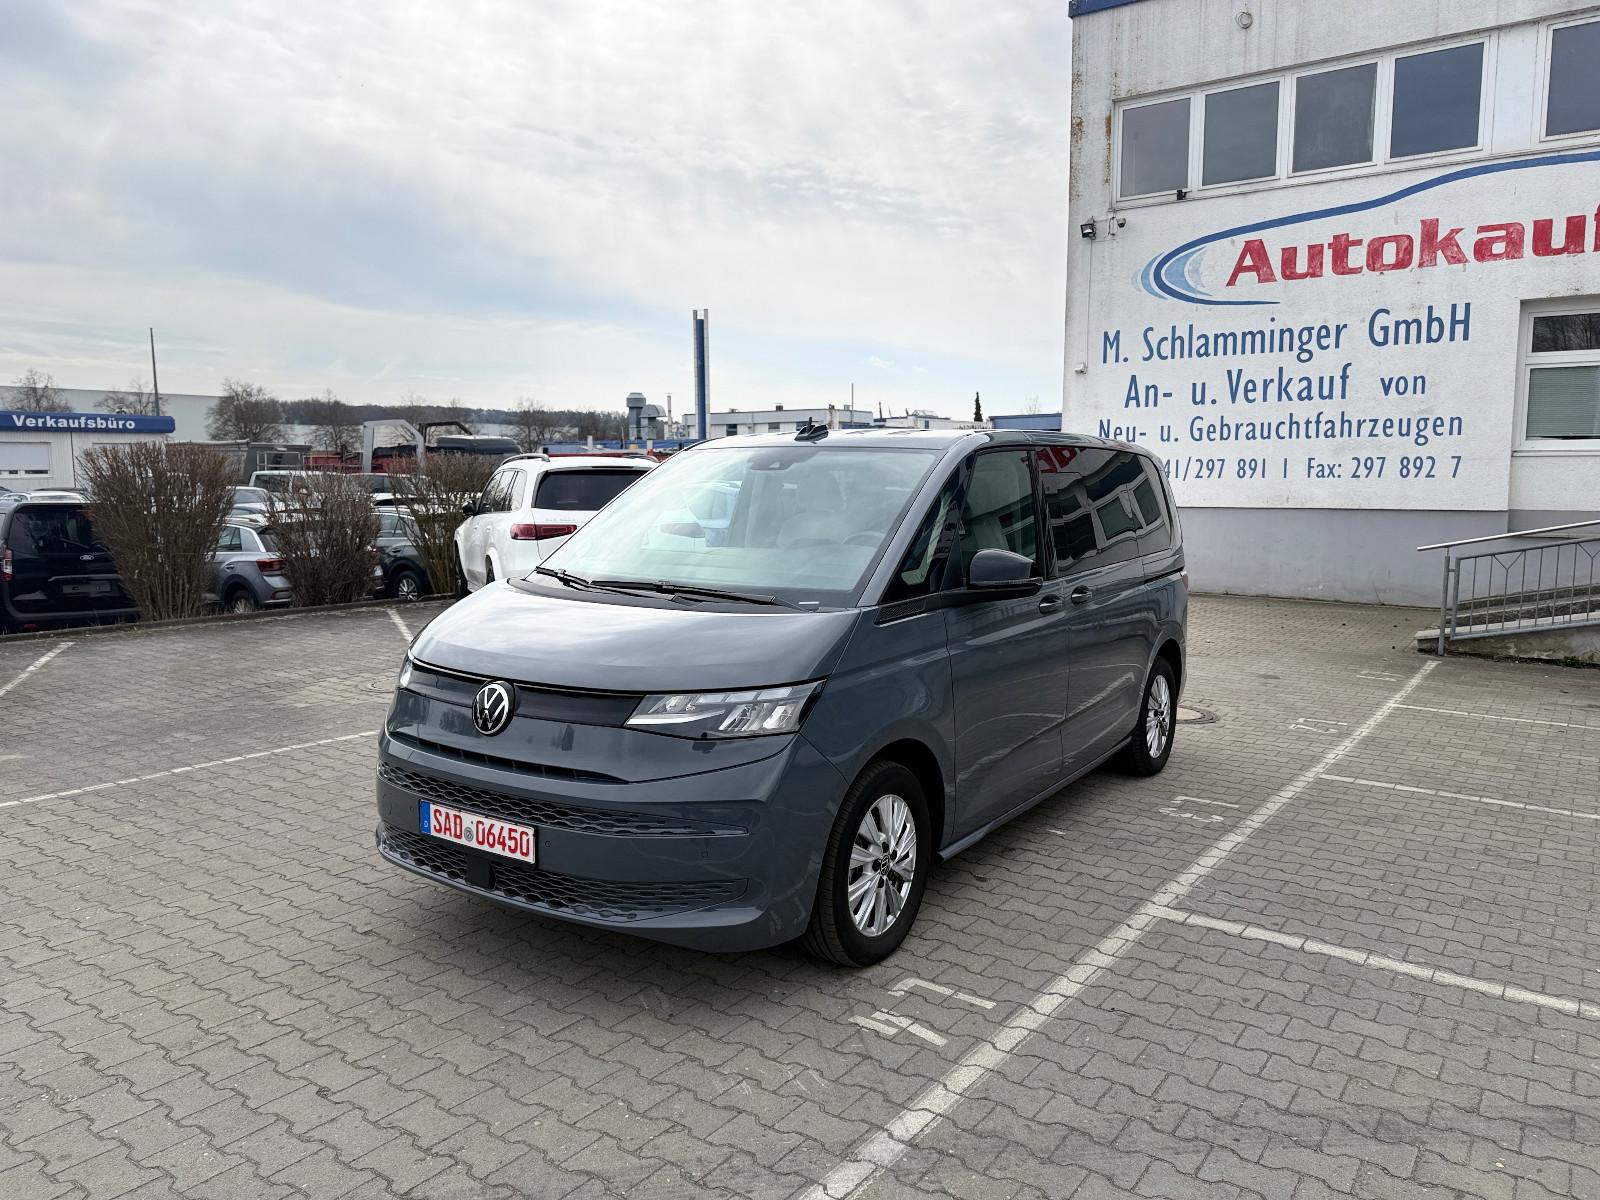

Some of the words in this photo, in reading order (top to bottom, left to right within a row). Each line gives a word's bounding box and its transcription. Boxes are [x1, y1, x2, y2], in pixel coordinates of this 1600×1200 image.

[1102, 330, 1129, 365] M.
[1142, 316, 1348, 363] Schlamminger
[1368, 302, 1472, 348] GmbH
[1123, 375, 1174, 408] An-
[1191, 382, 1218, 406] u.
[1226, 363, 1353, 405] Verkauf
[1379, 375, 1427, 397] von
[12, 414, 136, 430] Verkaufsbüro
[1099, 418, 1147, 443] Neu-
[1160, 424, 1180, 443] u.
[1189, 410, 1463, 446] Gebrauchtfahrzeugen
[1307, 457, 1342, 479] Fax:
[1350, 456, 1387, 479] 297
[1399, 456, 1436, 479] 892
[1451, 456, 1462, 479] 7
[433, 808, 463, 840] SAD
[475, 819, 530, 858] 06450
